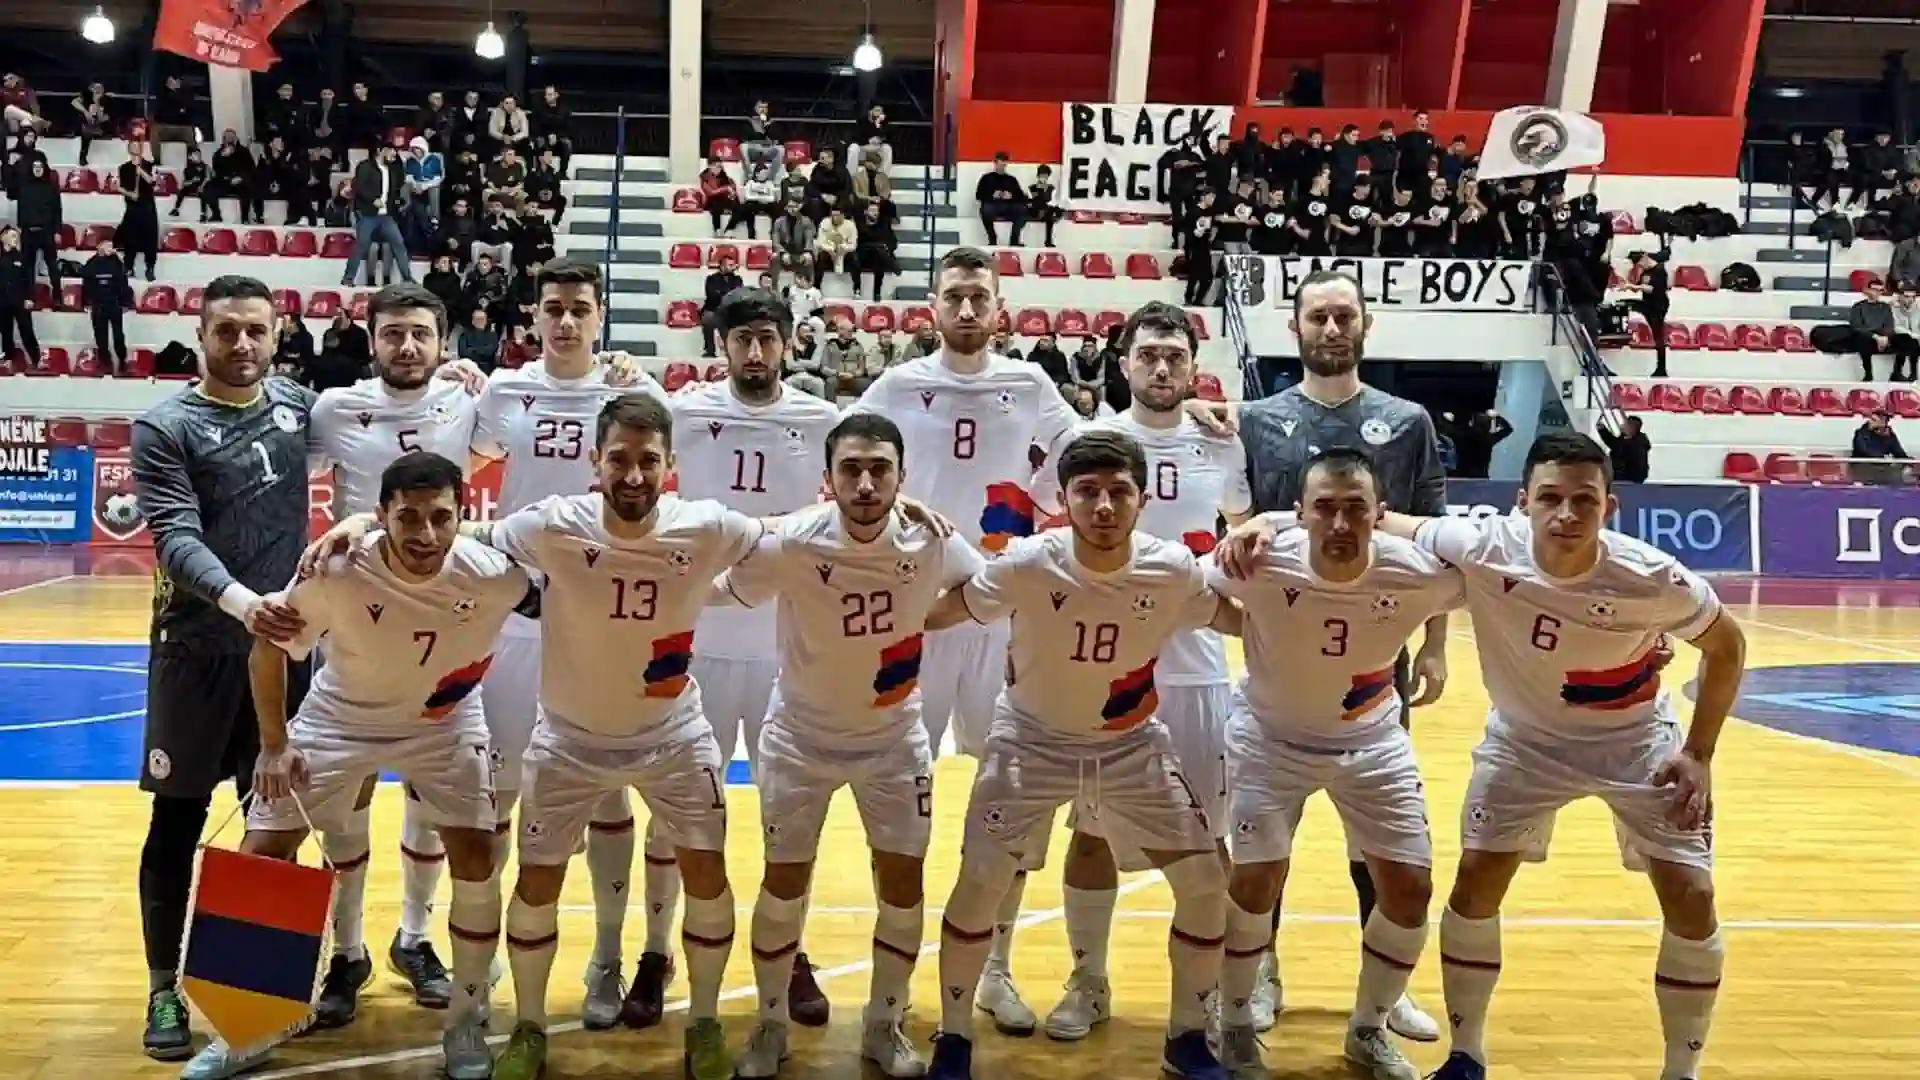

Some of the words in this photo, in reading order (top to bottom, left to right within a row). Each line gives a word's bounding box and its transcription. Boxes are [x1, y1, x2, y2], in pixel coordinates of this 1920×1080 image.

[1420, 260, 1523, 306] BOYS
[534, 419, 584, 460] 23
[954, 418, 976, 460] 8
[252, 441, 280, 483] 1
[730, 449, 767, 493] 11
[609, 577, 658, 621] 13
[840, 590, 894, 637] 22
[413, 630, 438, 667] 7
[1069, 621, 1120, 663] 18
[1321, 618, 1349, 657] 3
[1531, 613, 1562, 651] 6
